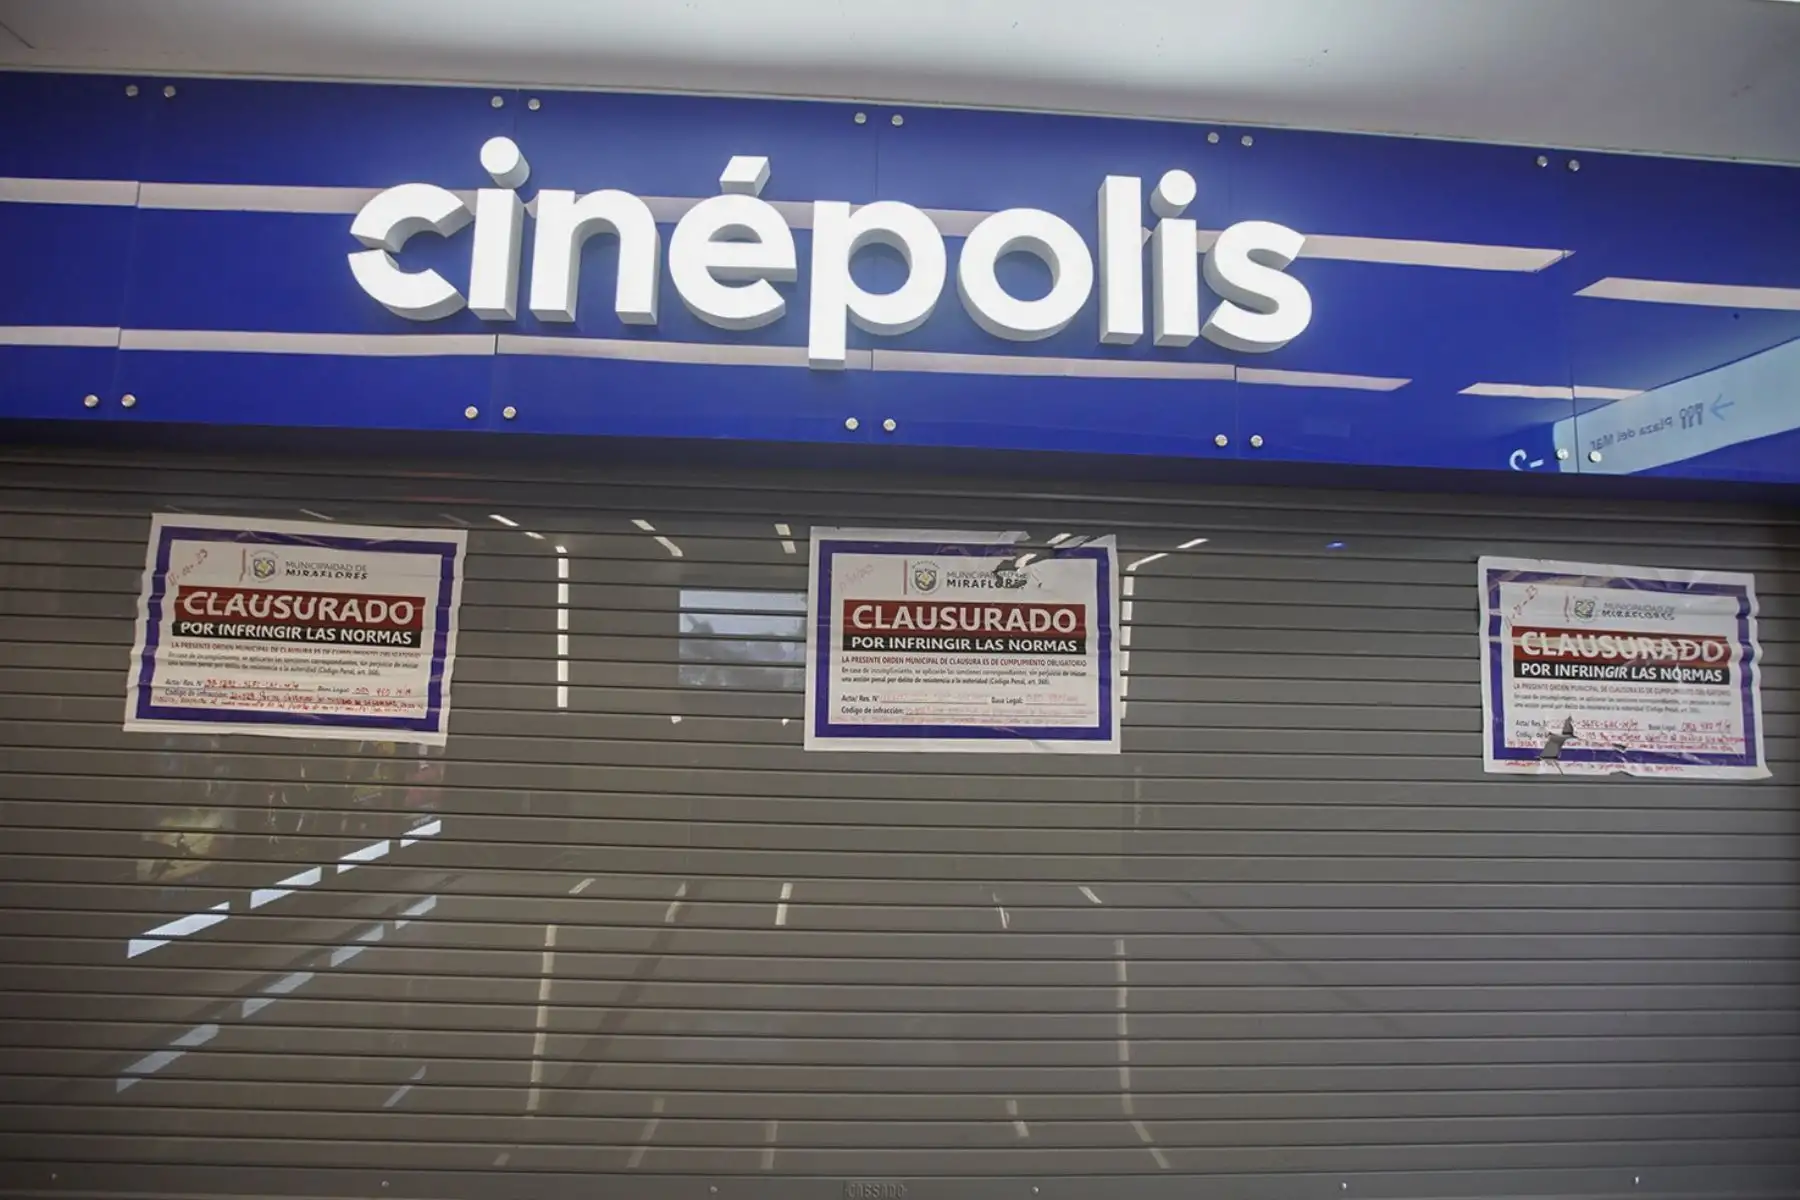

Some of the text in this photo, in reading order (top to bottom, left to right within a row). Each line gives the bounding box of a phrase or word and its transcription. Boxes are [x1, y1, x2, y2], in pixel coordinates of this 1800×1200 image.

[347, 136, 1313, 370] cinépolis
[285, 569, 368, 580] MIRAFLORES
[354, 564, 367, 572] DE
[183, 591, 414, 625] CLAUSURADO
[852, 605, 1076, 633] CLAUSURADO
[180, 621, 412, 644] POR INFRINGIR LAS NORMAS
[852, 636, 1077, 652] POR INFRINGIR LAS NORMAS
[1521, 631, 1724, 662] CLAUSURADO
[851, 656, 880, 664] PRESENTE
[882, 656, 904, 664] ORDEN
[905, 657, 939, 665] MUNICIPAL
[940, 657, 948, 665] DE
[1047, 659, 1087, 667] OBLIGATORIO
[1521, 663, 1722, 682] POR INFRINGIR LAS NORMAS
[841, 706, 863, 715] Código
